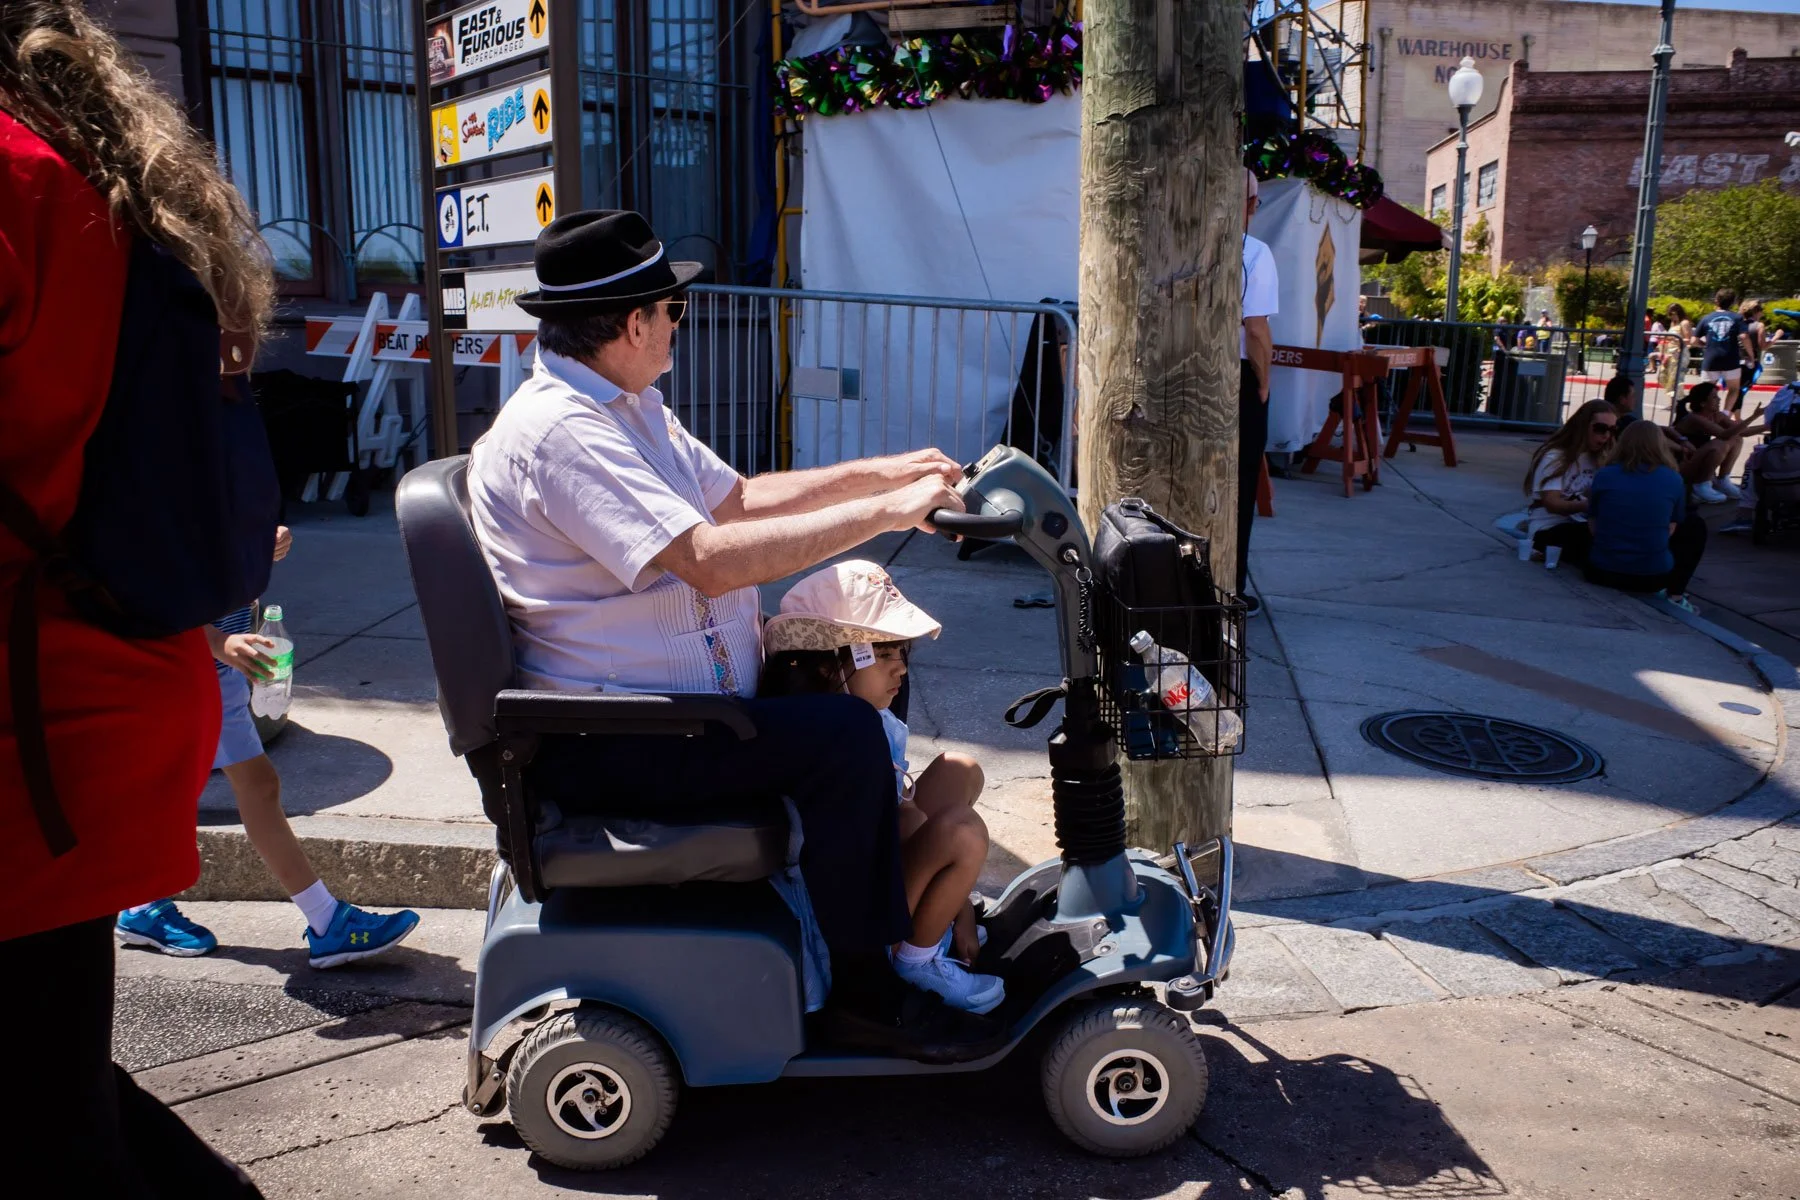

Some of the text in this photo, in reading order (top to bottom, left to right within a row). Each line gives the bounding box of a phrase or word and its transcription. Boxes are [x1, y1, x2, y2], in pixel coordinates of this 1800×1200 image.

[458, 6, 502, 45] FAST &
[461, 16, 526, 65] FURIOUS
[465, 39, 524, 67] SUPERCHARGED
[1397, 38, 1513, 60] WAREHOUSE
[487, 86, 527, 152] RIDE
[469, 290, 497, 312] ALIEN
[378, 333, 409, 351] BEAT
